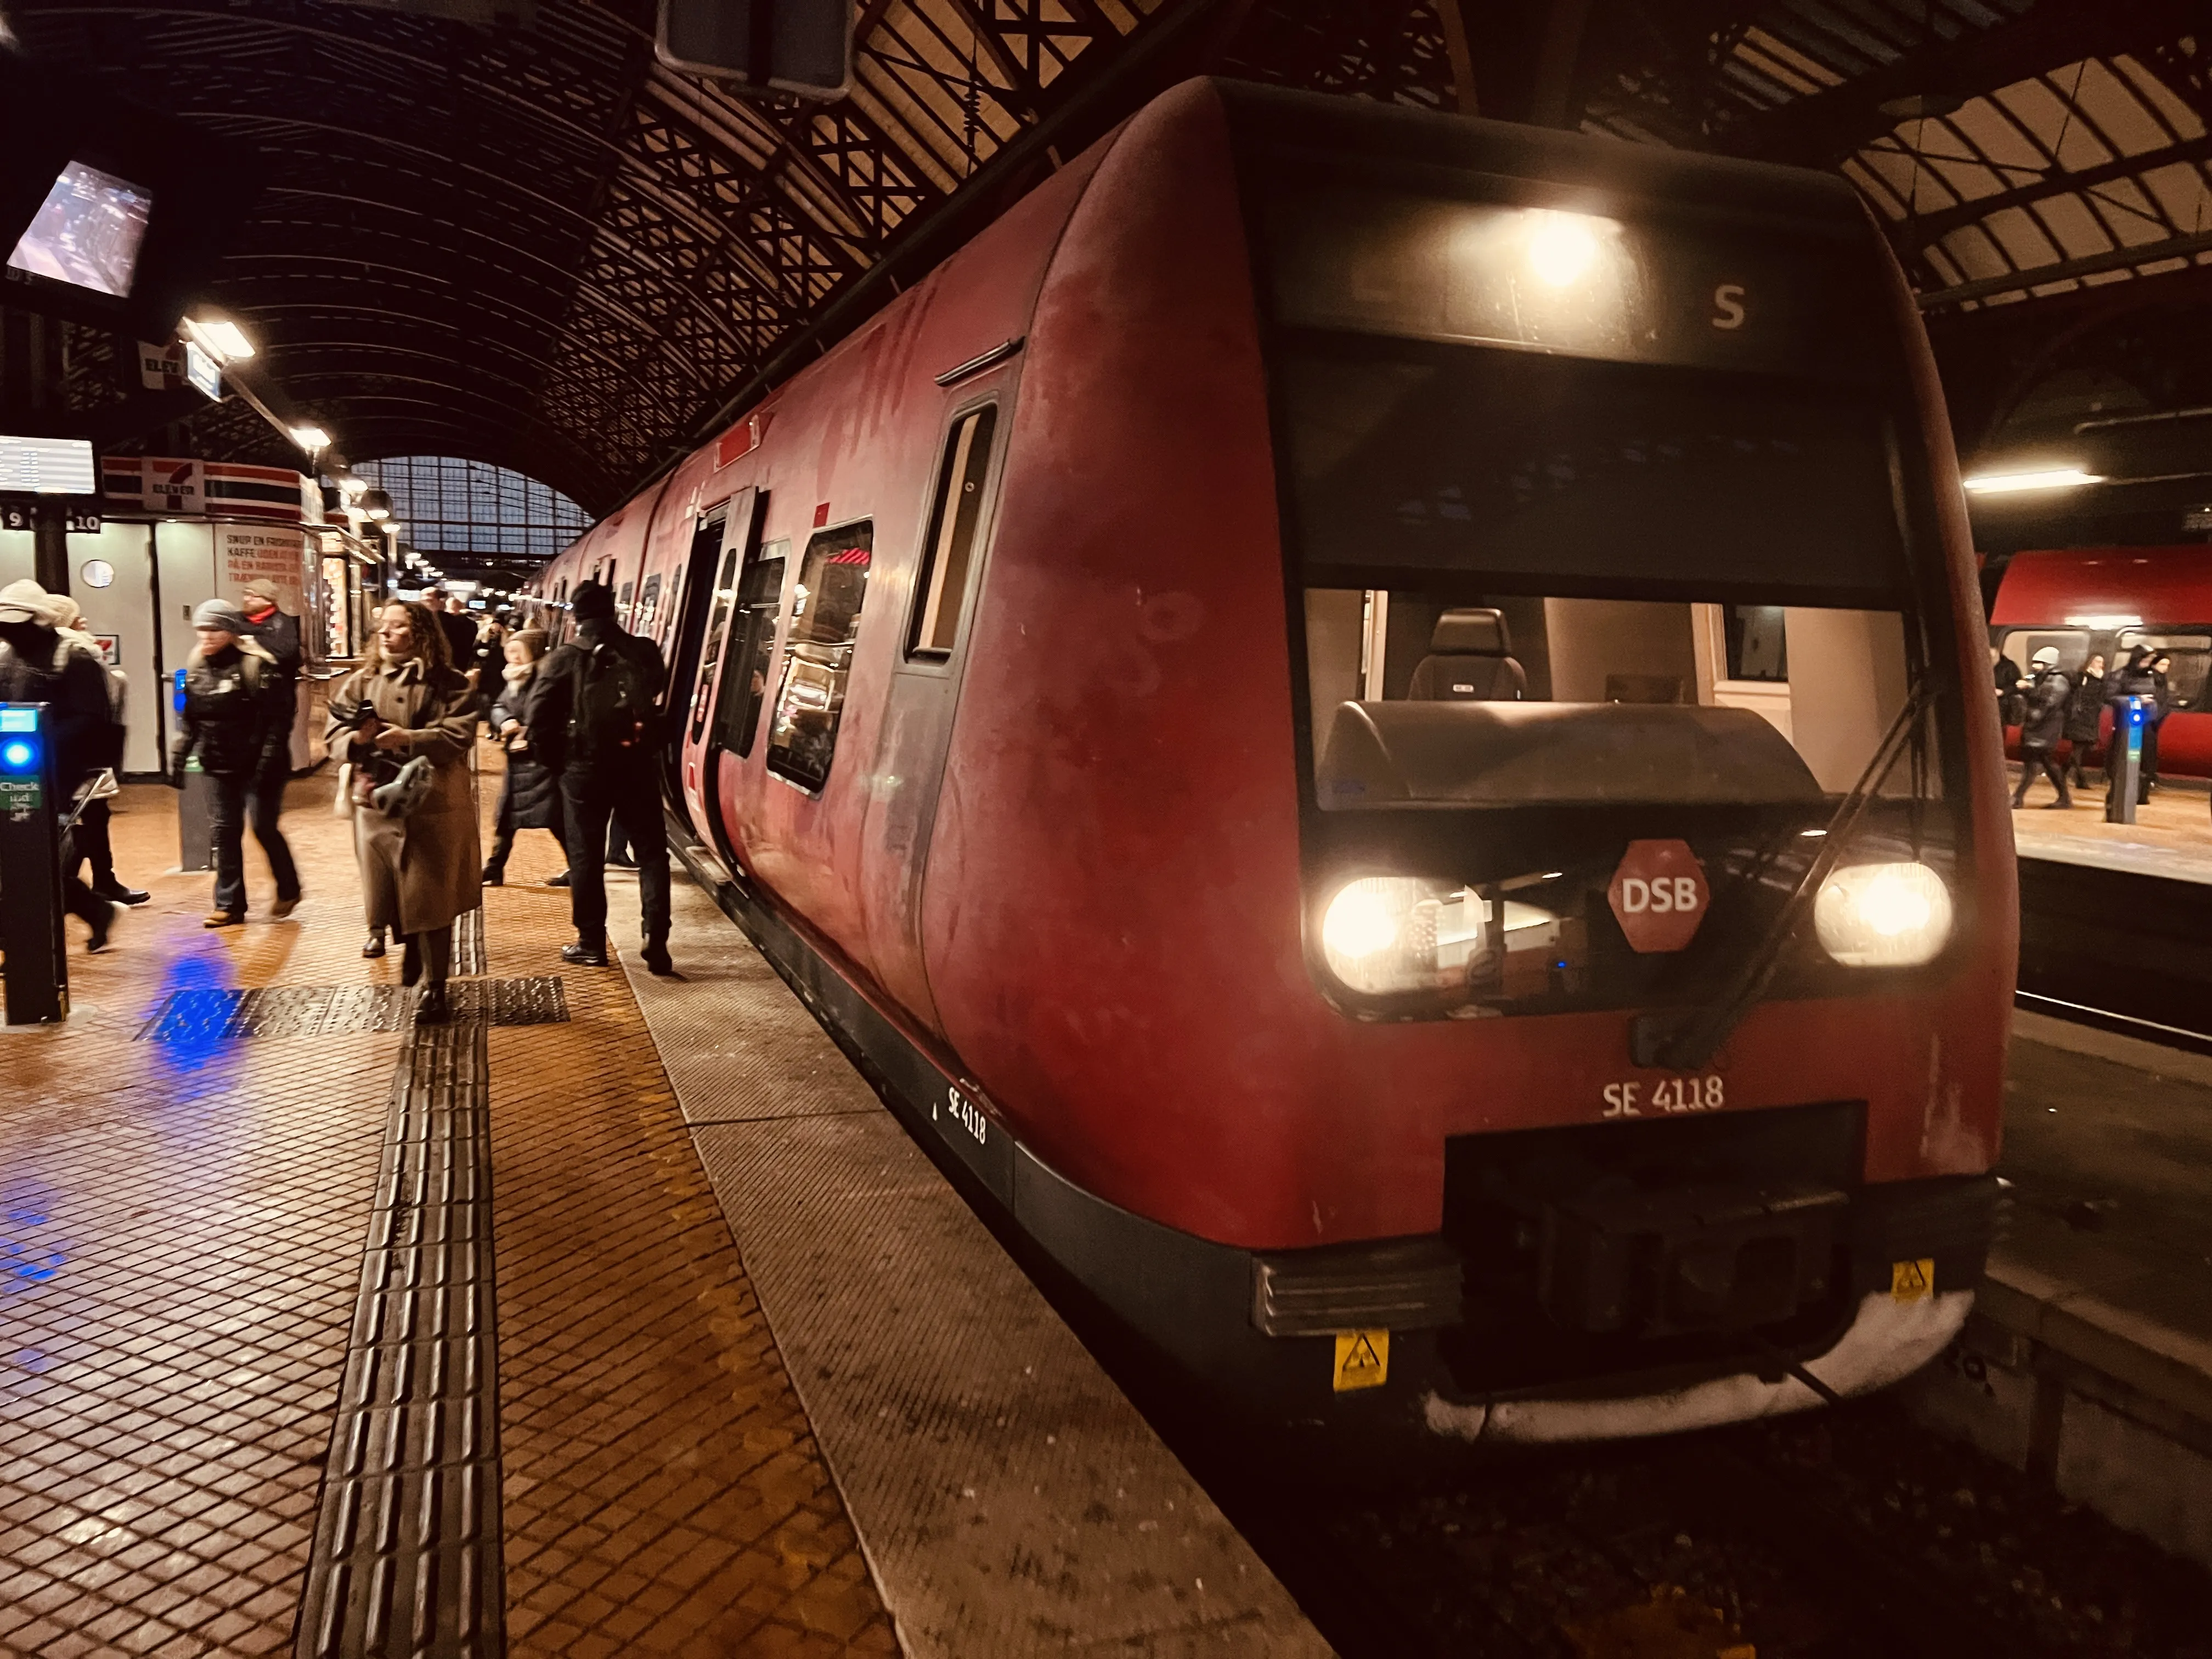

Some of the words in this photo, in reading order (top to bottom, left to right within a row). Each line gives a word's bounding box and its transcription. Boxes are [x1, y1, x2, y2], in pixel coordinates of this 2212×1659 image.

[1712, 284, 1745, 329] S
[9, 512, 24, 527] 9
[76, 516, 100, 531] 10
[227, 547, 257, 558] KAFFE
[0, 781, 40, 791] Check
[1622, 877, 1697, 913] DSB
[1603, 1082, 1642, 1117] SE
[1651, 1075, 1724, 1113] 4118
[949, 1087, 960, 1119] SE
[962, 1100, 986, 1145] 4118
